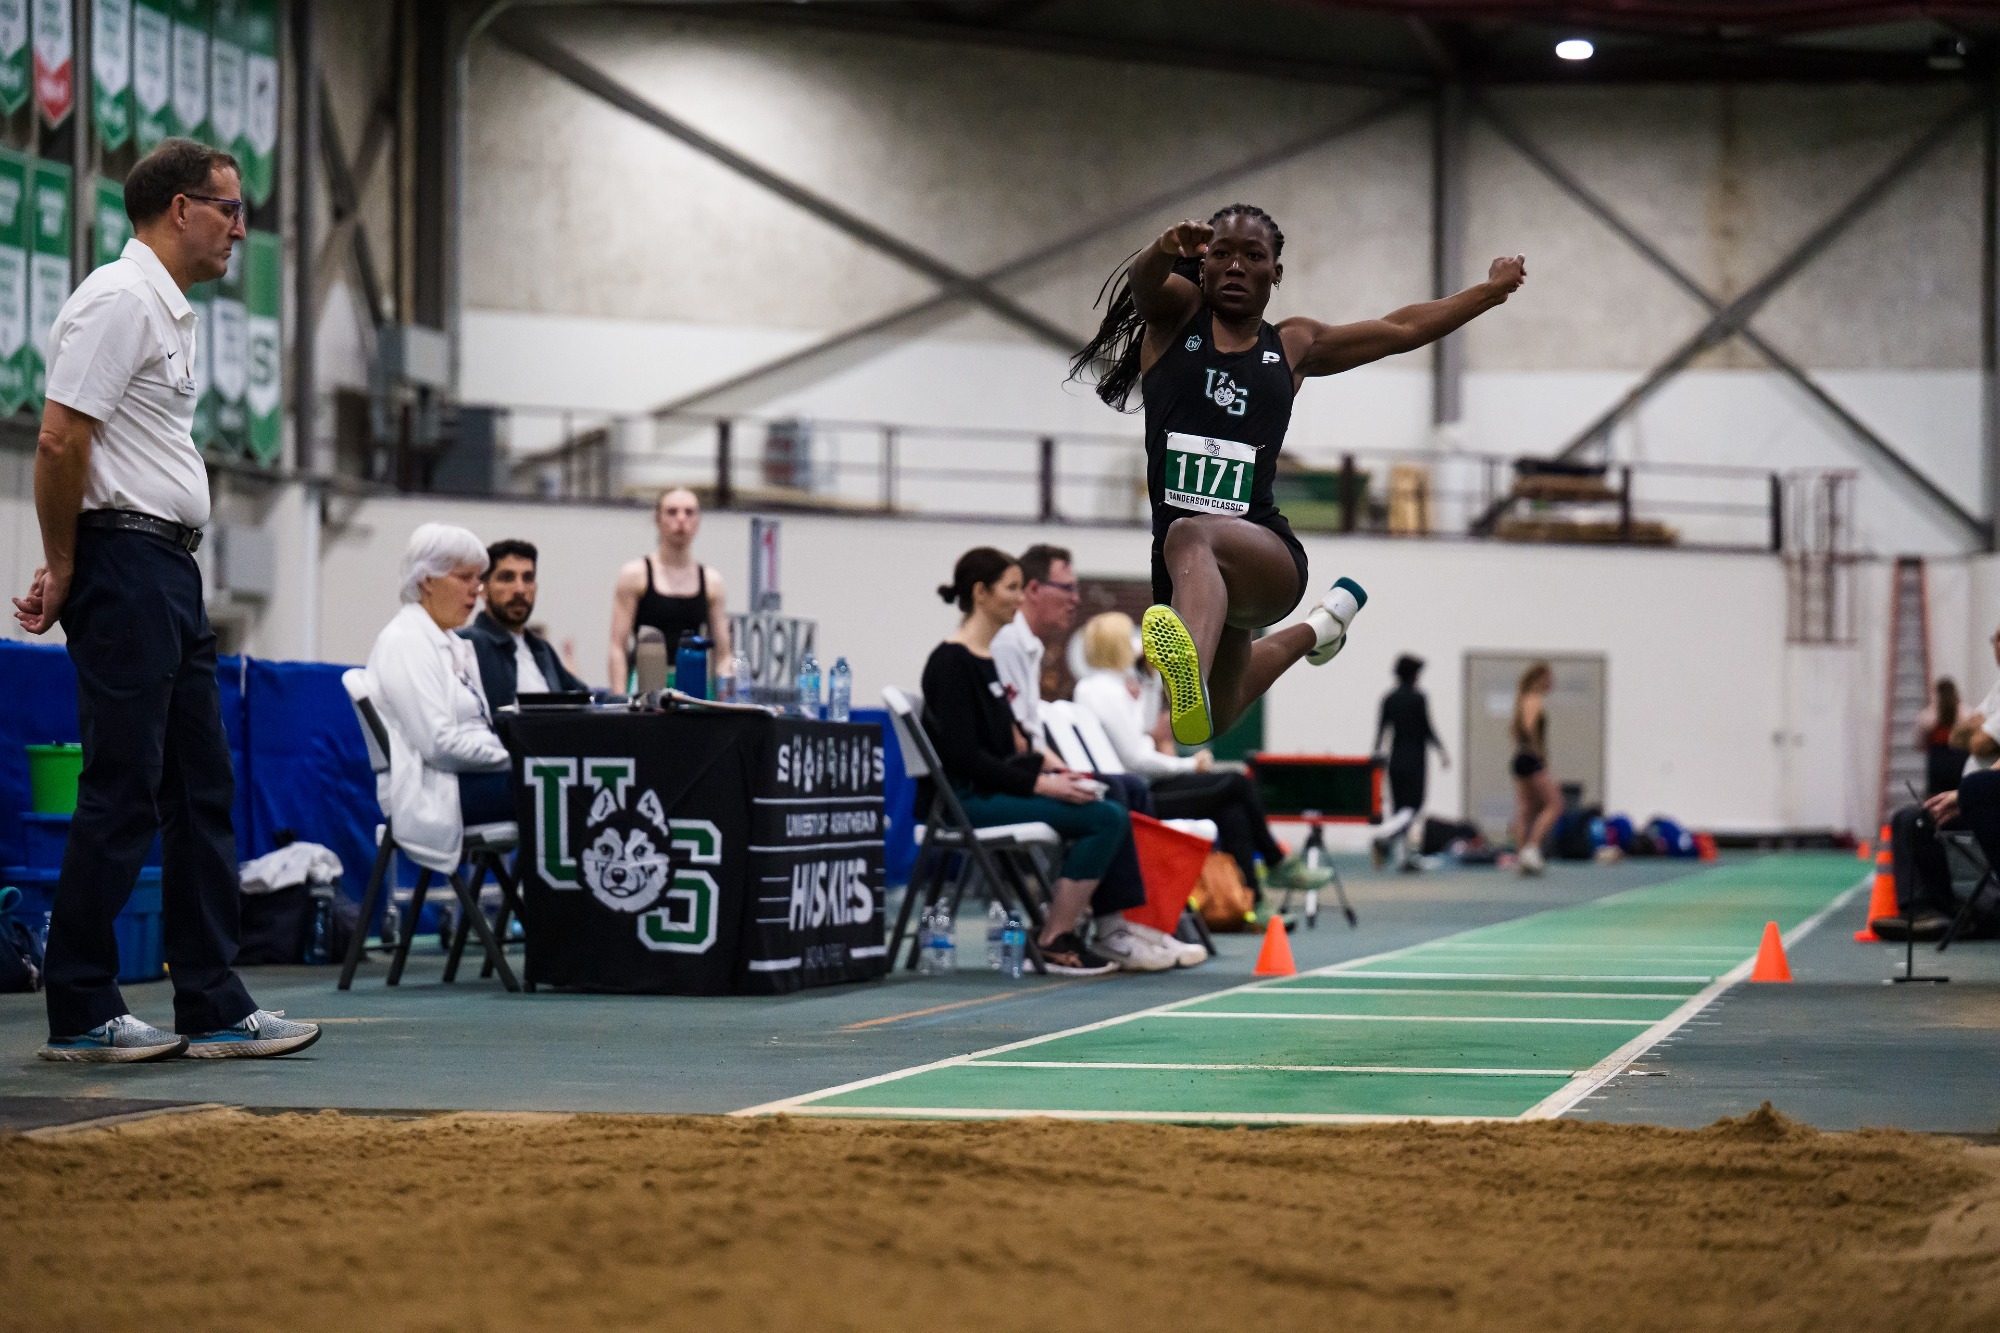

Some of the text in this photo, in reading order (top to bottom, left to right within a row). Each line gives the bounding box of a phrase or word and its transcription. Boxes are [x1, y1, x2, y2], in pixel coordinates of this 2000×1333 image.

[1177, 453, 1245, 499] 1171
[1169, 492, 1244, 512] SANDERSON CLASSIC
